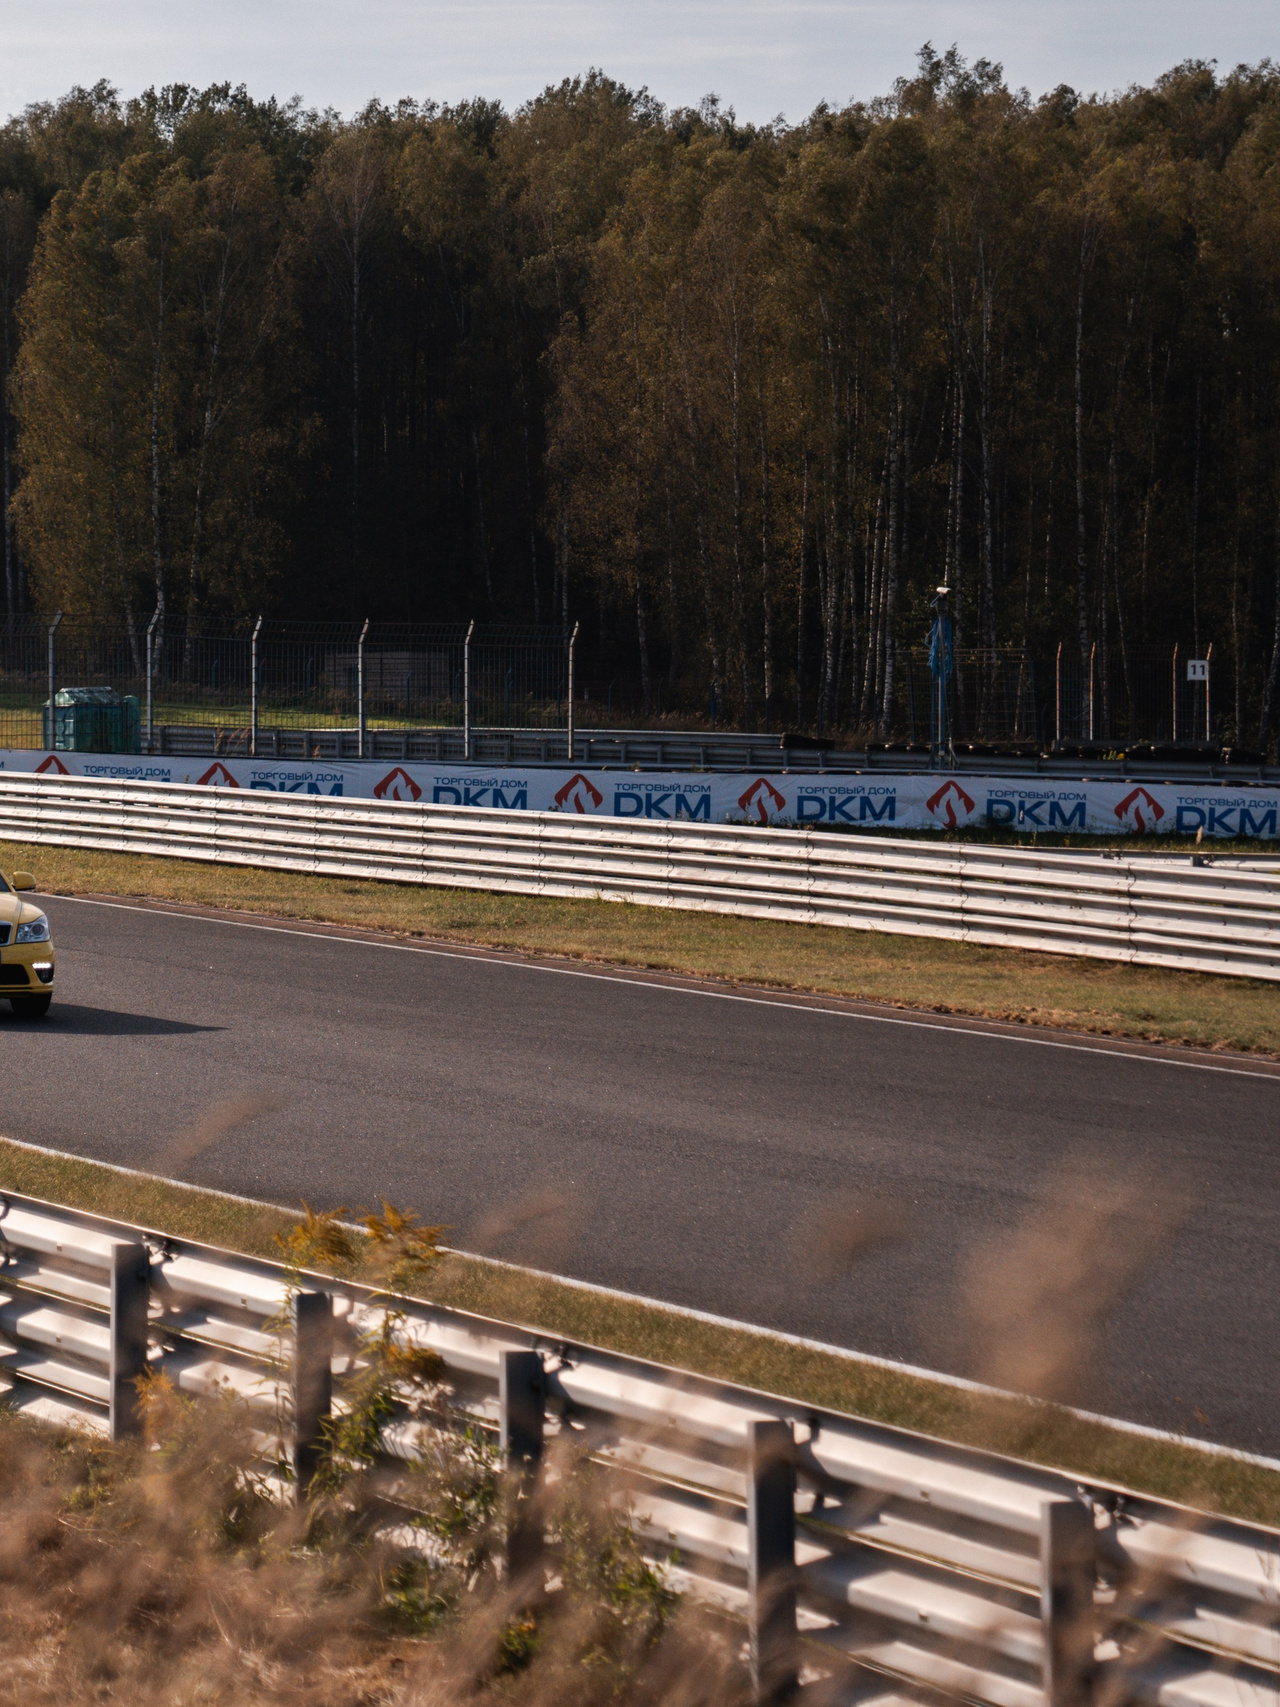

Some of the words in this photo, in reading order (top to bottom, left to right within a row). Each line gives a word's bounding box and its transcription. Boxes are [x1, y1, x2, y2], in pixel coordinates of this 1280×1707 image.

[1190, 664, 1205, 676] 11
[84, 765, 143, 776] ТОРГОВЫЙ
[145, 768, 171, 777] ДОМ
[251, 771, 313, 781] ТОРГОВЫЙ
[315, 773, 344, 783] ДОМ
[434, 777, 498, 787] ТОРГОВЫЙ
[500, 779, 528, 789] ДОМ
[615, 783, 681, 792] ТОРГОВЫЙ
[683, 784, 711, 793] ДОМ
[797, 786, 865, 795] ТОРГОВЫЙ
[867, 787, 897, 796] ДОМ
[987, 789, 1056, 799] ТОРГОВЫЙ
[1057, 792, 1087, 801] ДОМ
[433, 785, 528, 810] DKM
[1177, 796, 1246, 807] ТОРГОВЫЙ
[1247, 799, 1278, 809] ДОМ
[614, 792, 711, 819] DKM
[797, 795, 896, 822] DKM
[986, 798, 1086, 827] DKM
[1176, 805, 1277, 835] DKM
